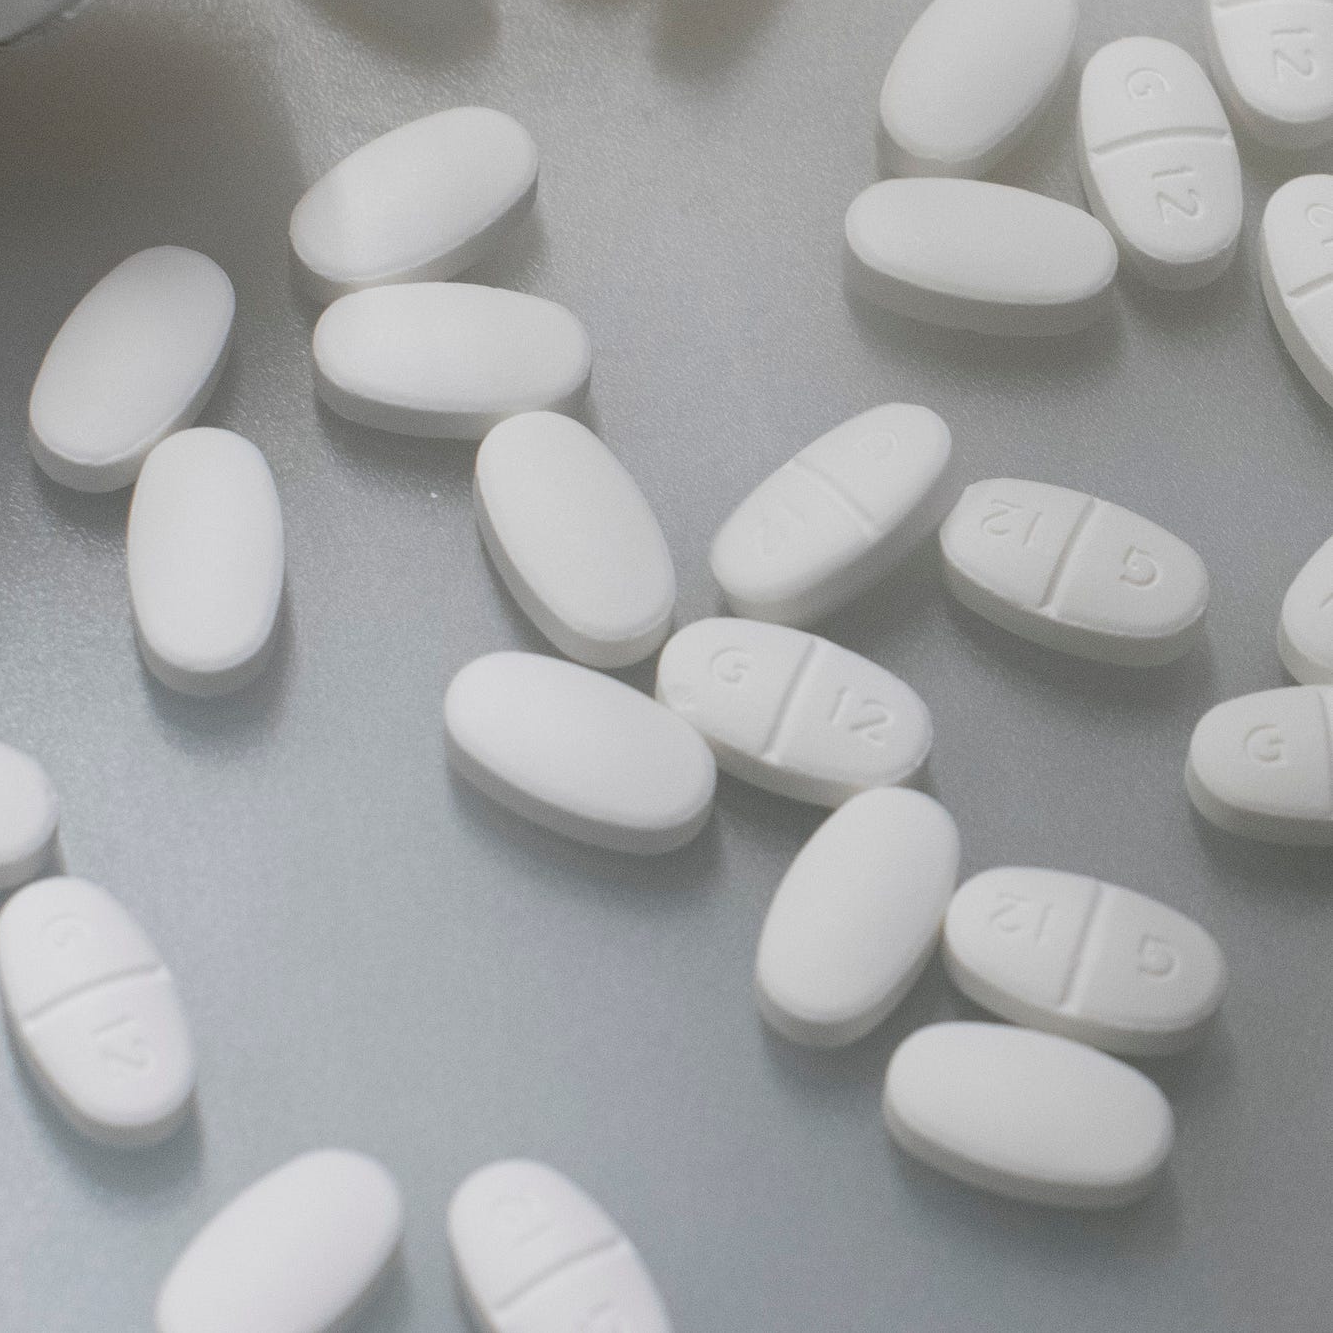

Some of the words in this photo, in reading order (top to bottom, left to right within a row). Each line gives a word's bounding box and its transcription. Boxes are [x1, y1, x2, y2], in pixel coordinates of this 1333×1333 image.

[1270, 27, 1315, 83] 12
[1151, 167, 1201, 223] 12
[979, 498, 1044, 547] 12
[827, 683, 895, 747] 12
